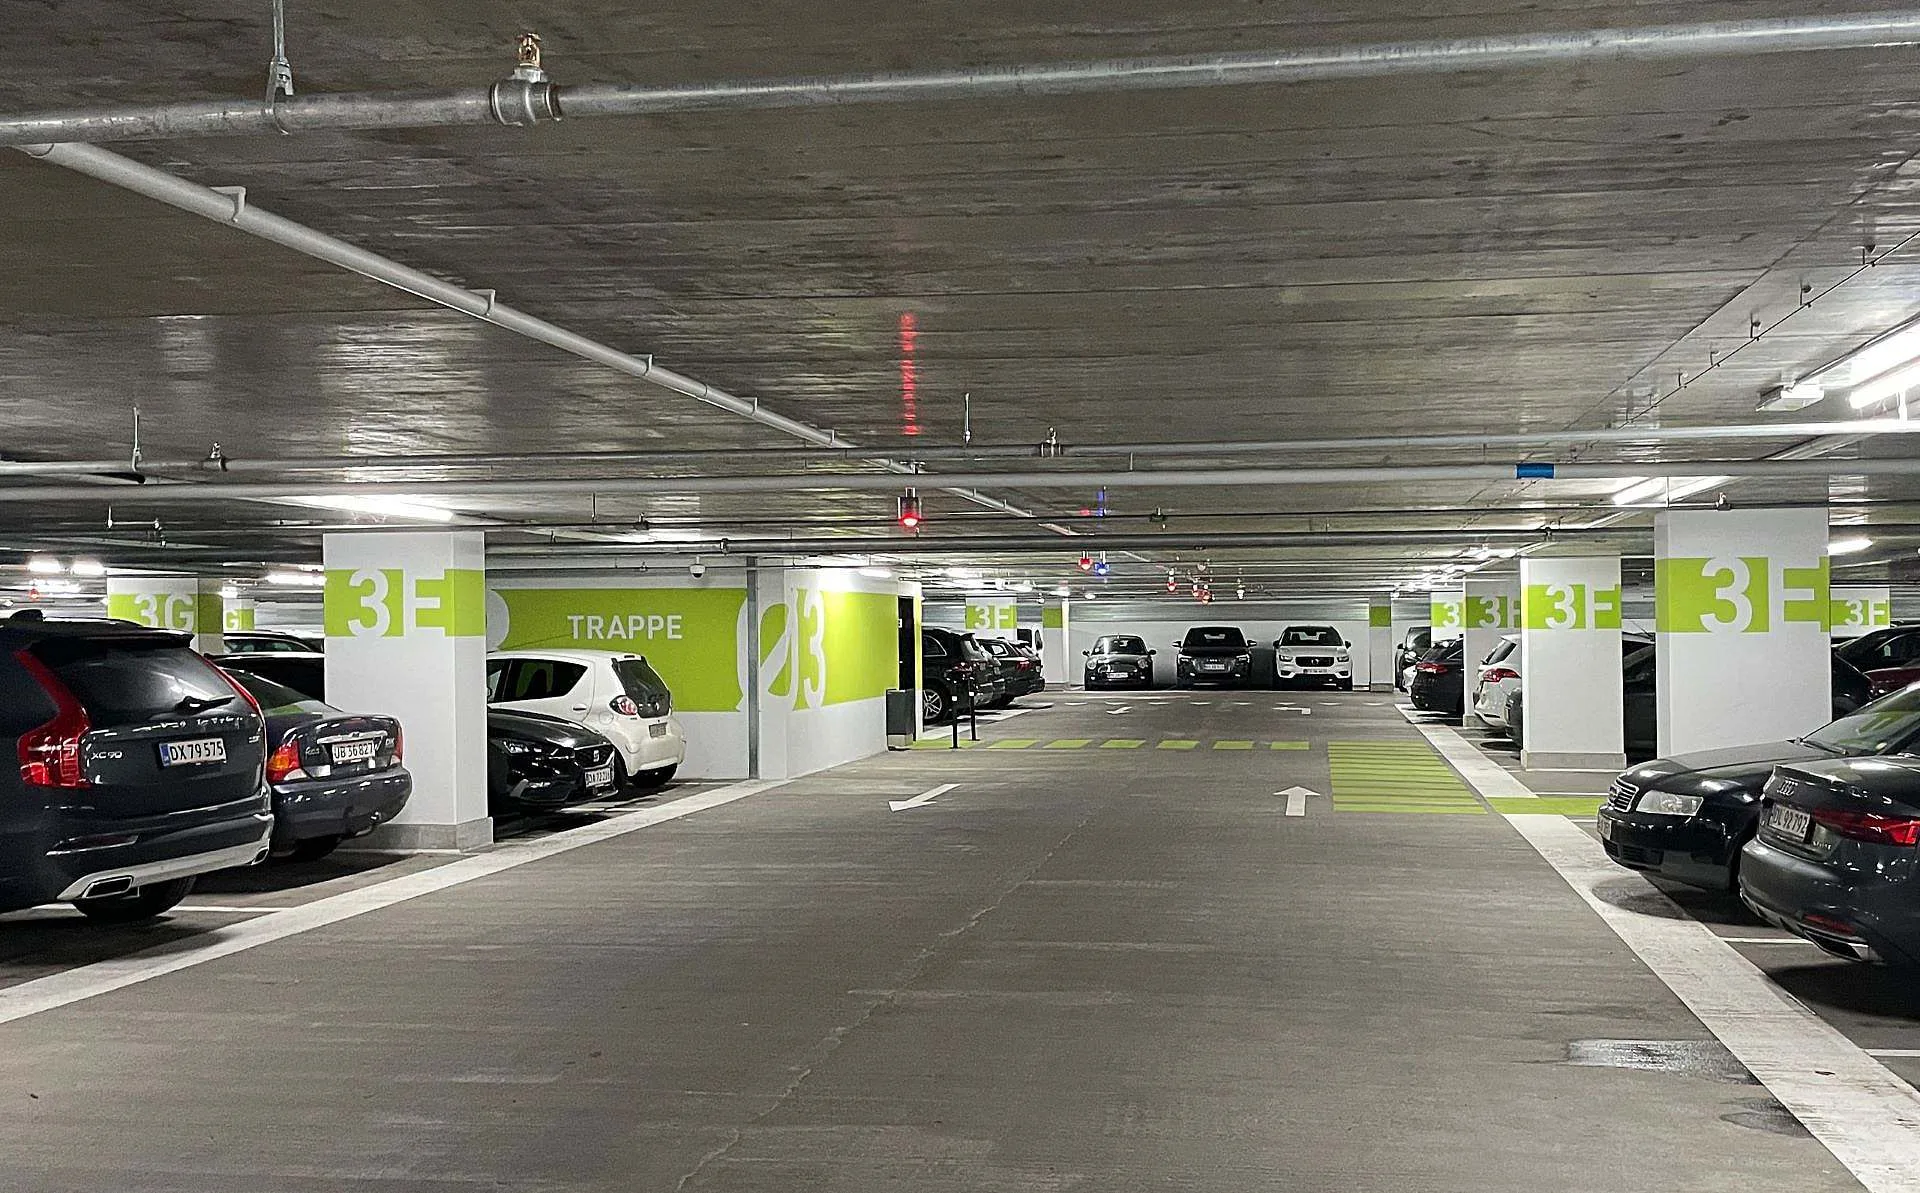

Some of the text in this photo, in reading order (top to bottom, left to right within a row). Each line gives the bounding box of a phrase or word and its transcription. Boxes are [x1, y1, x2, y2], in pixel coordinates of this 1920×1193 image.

[134, 591, 194, 632] 3G
[347, 568, 447, 638] 3E
[1545, 583, 1616, 631] 3F
[1700, 556, 1821, 633] 3E
[567, 615, 683, 640] TRAPPE
[974, 605, 1012, 630] 3F
[1845, 599, 1887, 626] 3F
[91, 751, 123, 760] XC90
